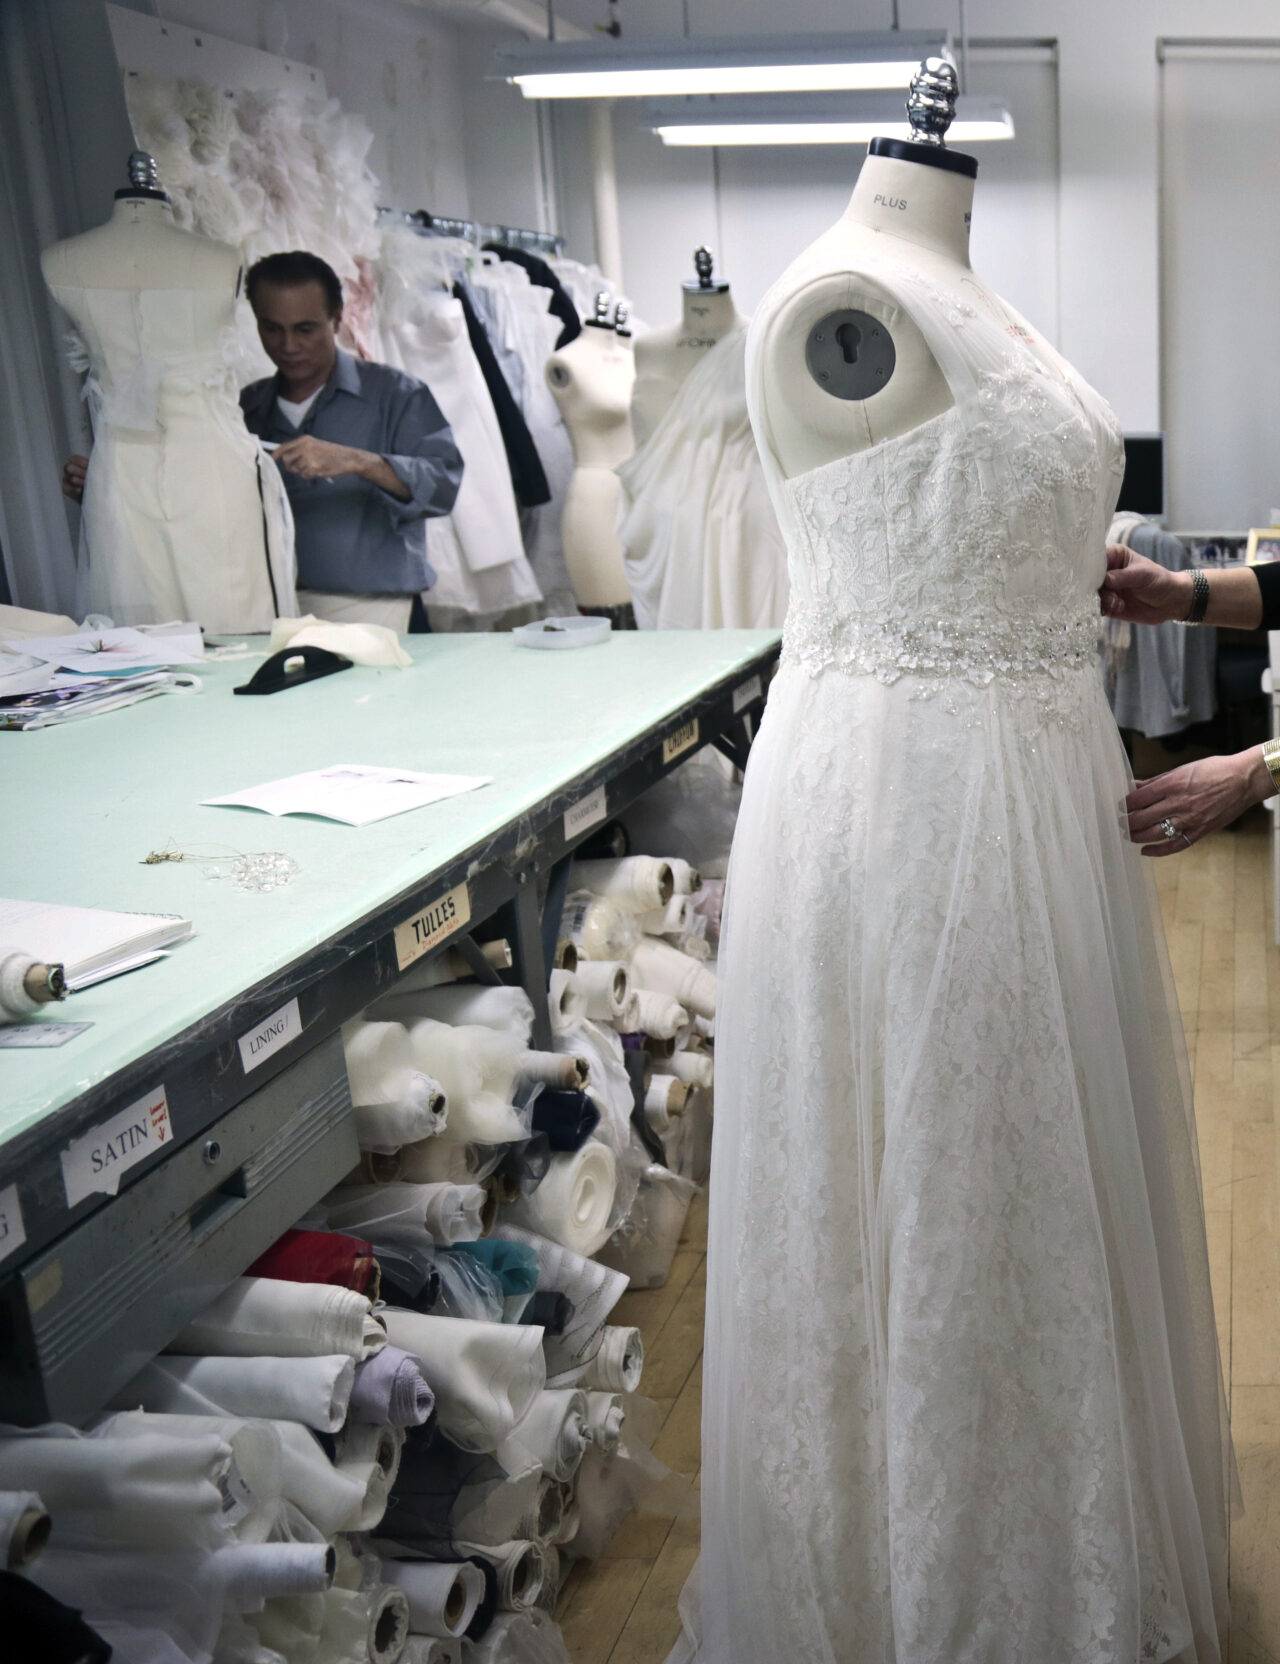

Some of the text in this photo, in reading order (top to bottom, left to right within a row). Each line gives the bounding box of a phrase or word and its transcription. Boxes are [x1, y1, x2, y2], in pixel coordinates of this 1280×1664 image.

[873, 194, 908, 211] PLUS
[411, 896, 456, 945] TULLES
[249, 1019, 285, 1055] LINING
[91, 1117, 148, 1174] SATIN
